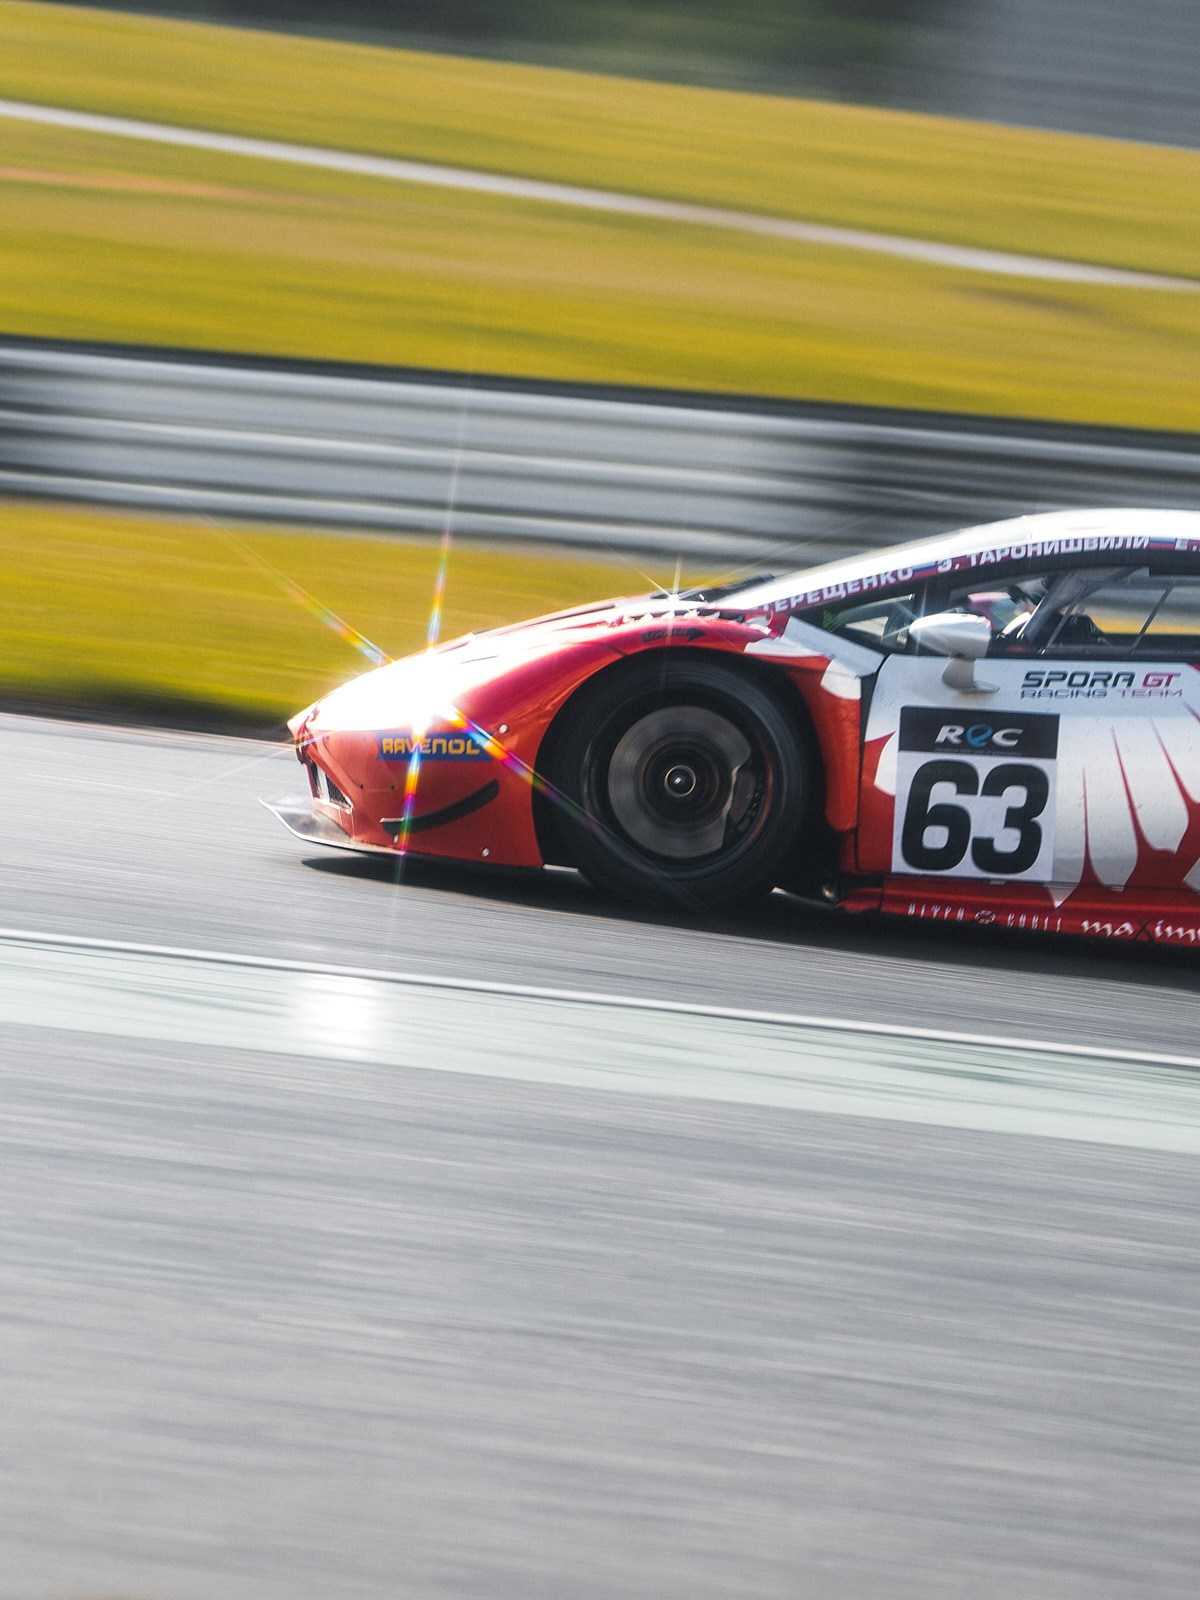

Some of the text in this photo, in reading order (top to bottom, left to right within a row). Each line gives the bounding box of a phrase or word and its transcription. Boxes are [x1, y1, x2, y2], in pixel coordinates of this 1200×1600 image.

[1021, 671, 1182, 688] SPORA GT
[1020, 689, 1183, 700] RACING TEAM
[382, 737, 480, 755] RAVENOL
[901, 758, 1049, 874] 63
